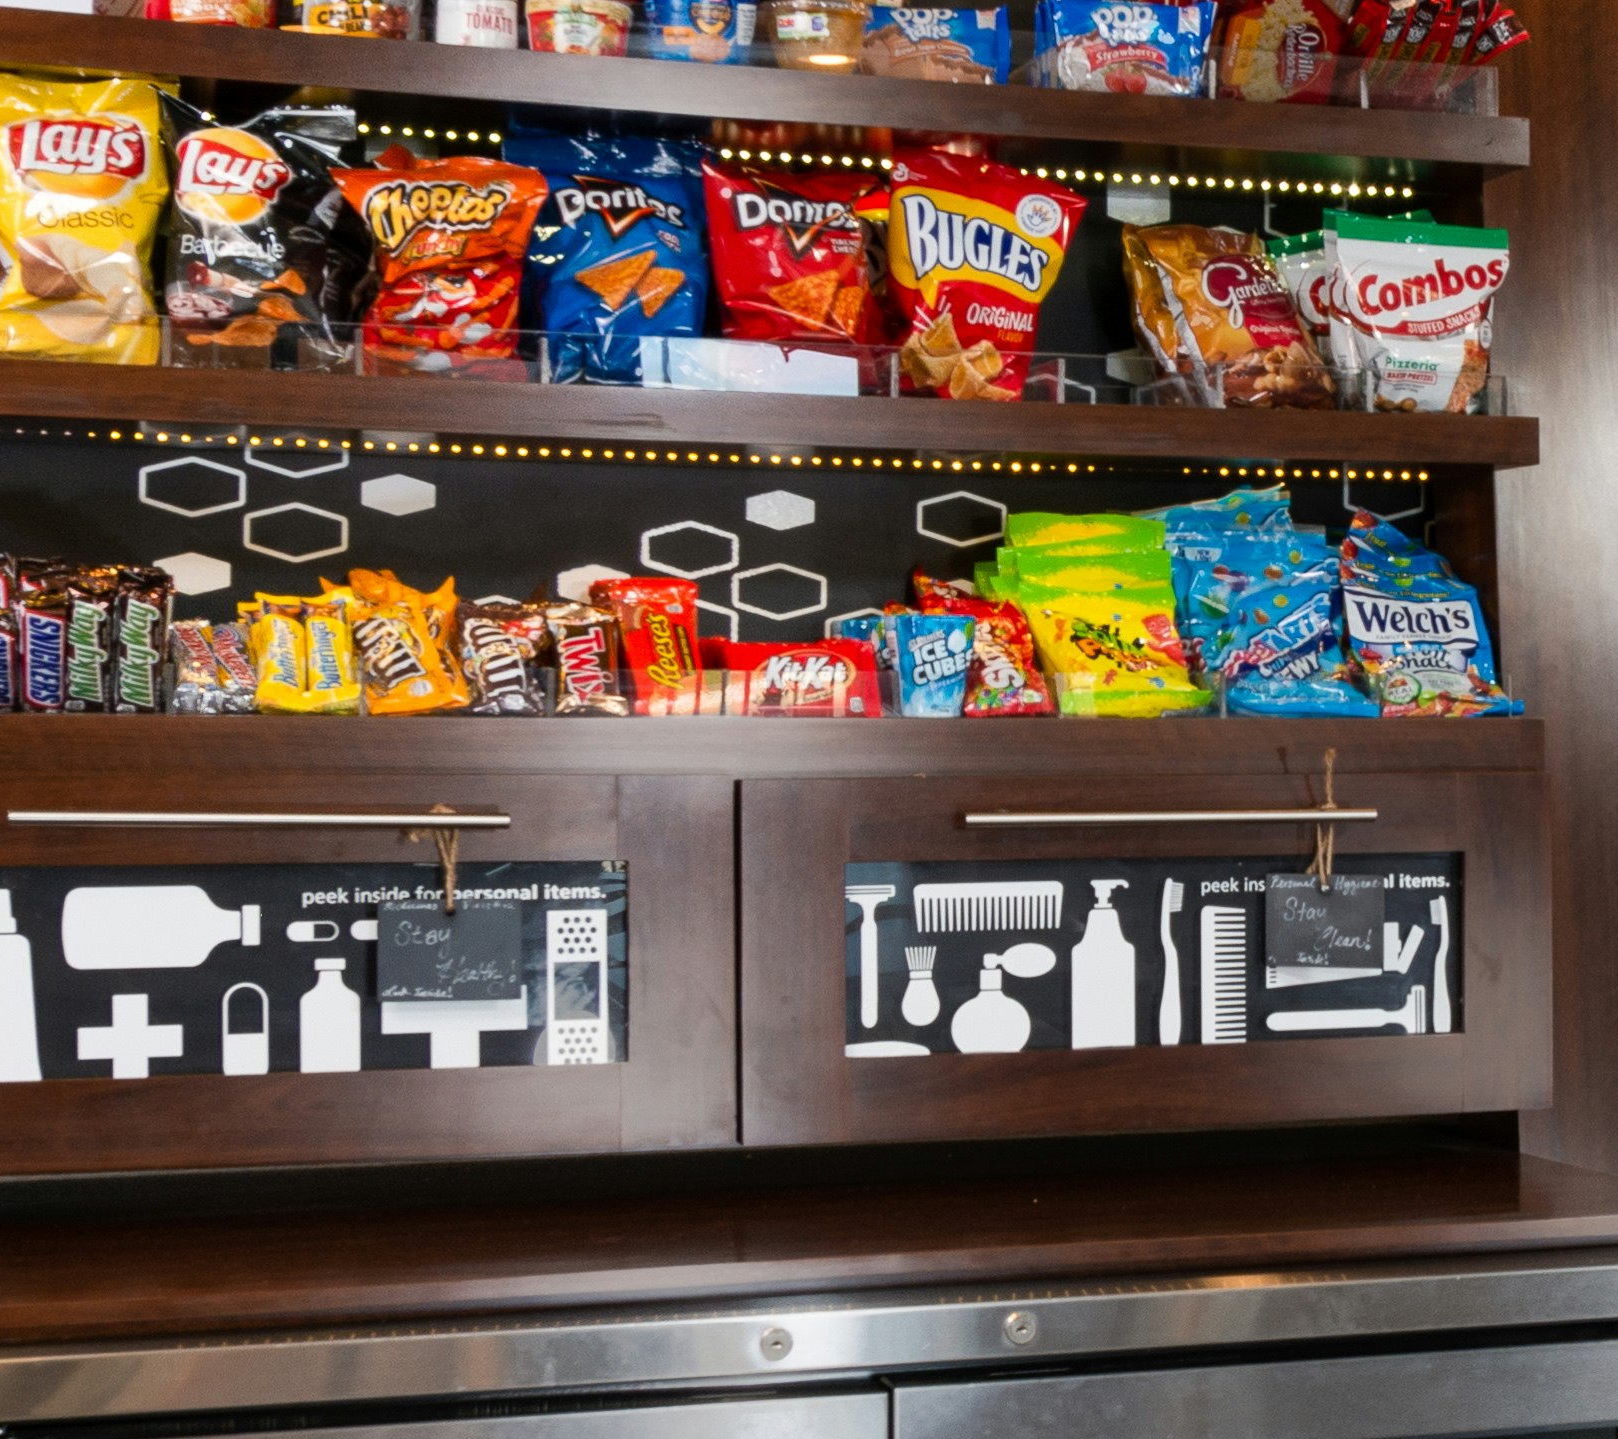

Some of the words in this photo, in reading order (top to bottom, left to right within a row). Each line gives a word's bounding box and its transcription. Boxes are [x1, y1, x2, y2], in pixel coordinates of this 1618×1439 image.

[465, 12, 514, 35] TOMATO
[1094, 46, 1159, 64] Strawberry
[1295, 32, 1320, 81] Orville
[16, 119, 144, 174] Lay's
[178, 137, 291, 195] Lay's
[35, 203, 136, 231] Classic
[368, 184, 507, 251] Cheetos
[554, 186, 684, 228] Doritos
[735, 192, 860, 228] Doritos
[180, 233, 286, 261] Barbecue
[900, 193, 1050, 293] BUGLES
[1357, 258, 1505, 317] Combos
[996, 329, 1024, 343] FLAVOR
[1385, 356, 1438, 372] Pizzeria
[1352, 599, 1471, 635] Welch's
[26, 615, 64, 706] SNICKERS
[911, 649, 974, 687] CUBES
[912, 642, 949, 664] ICE
[301, 886, 349, 909] peek
[353, 884, 411, 903] inside
[414, 885, 444, 901] for
[451, 882, 539, 902] personal
[543, 882, 608, 901] items.
[1200, 876, 1240, 897] peek
[1243, 876, 1266, 893] ins
[1398, 872, 1452, 890] items.
[1270, 875, 1317, 890] Personal
[1334, 875, 1383, 896] Hygiene
[394, 920, 452, 960] Stay
